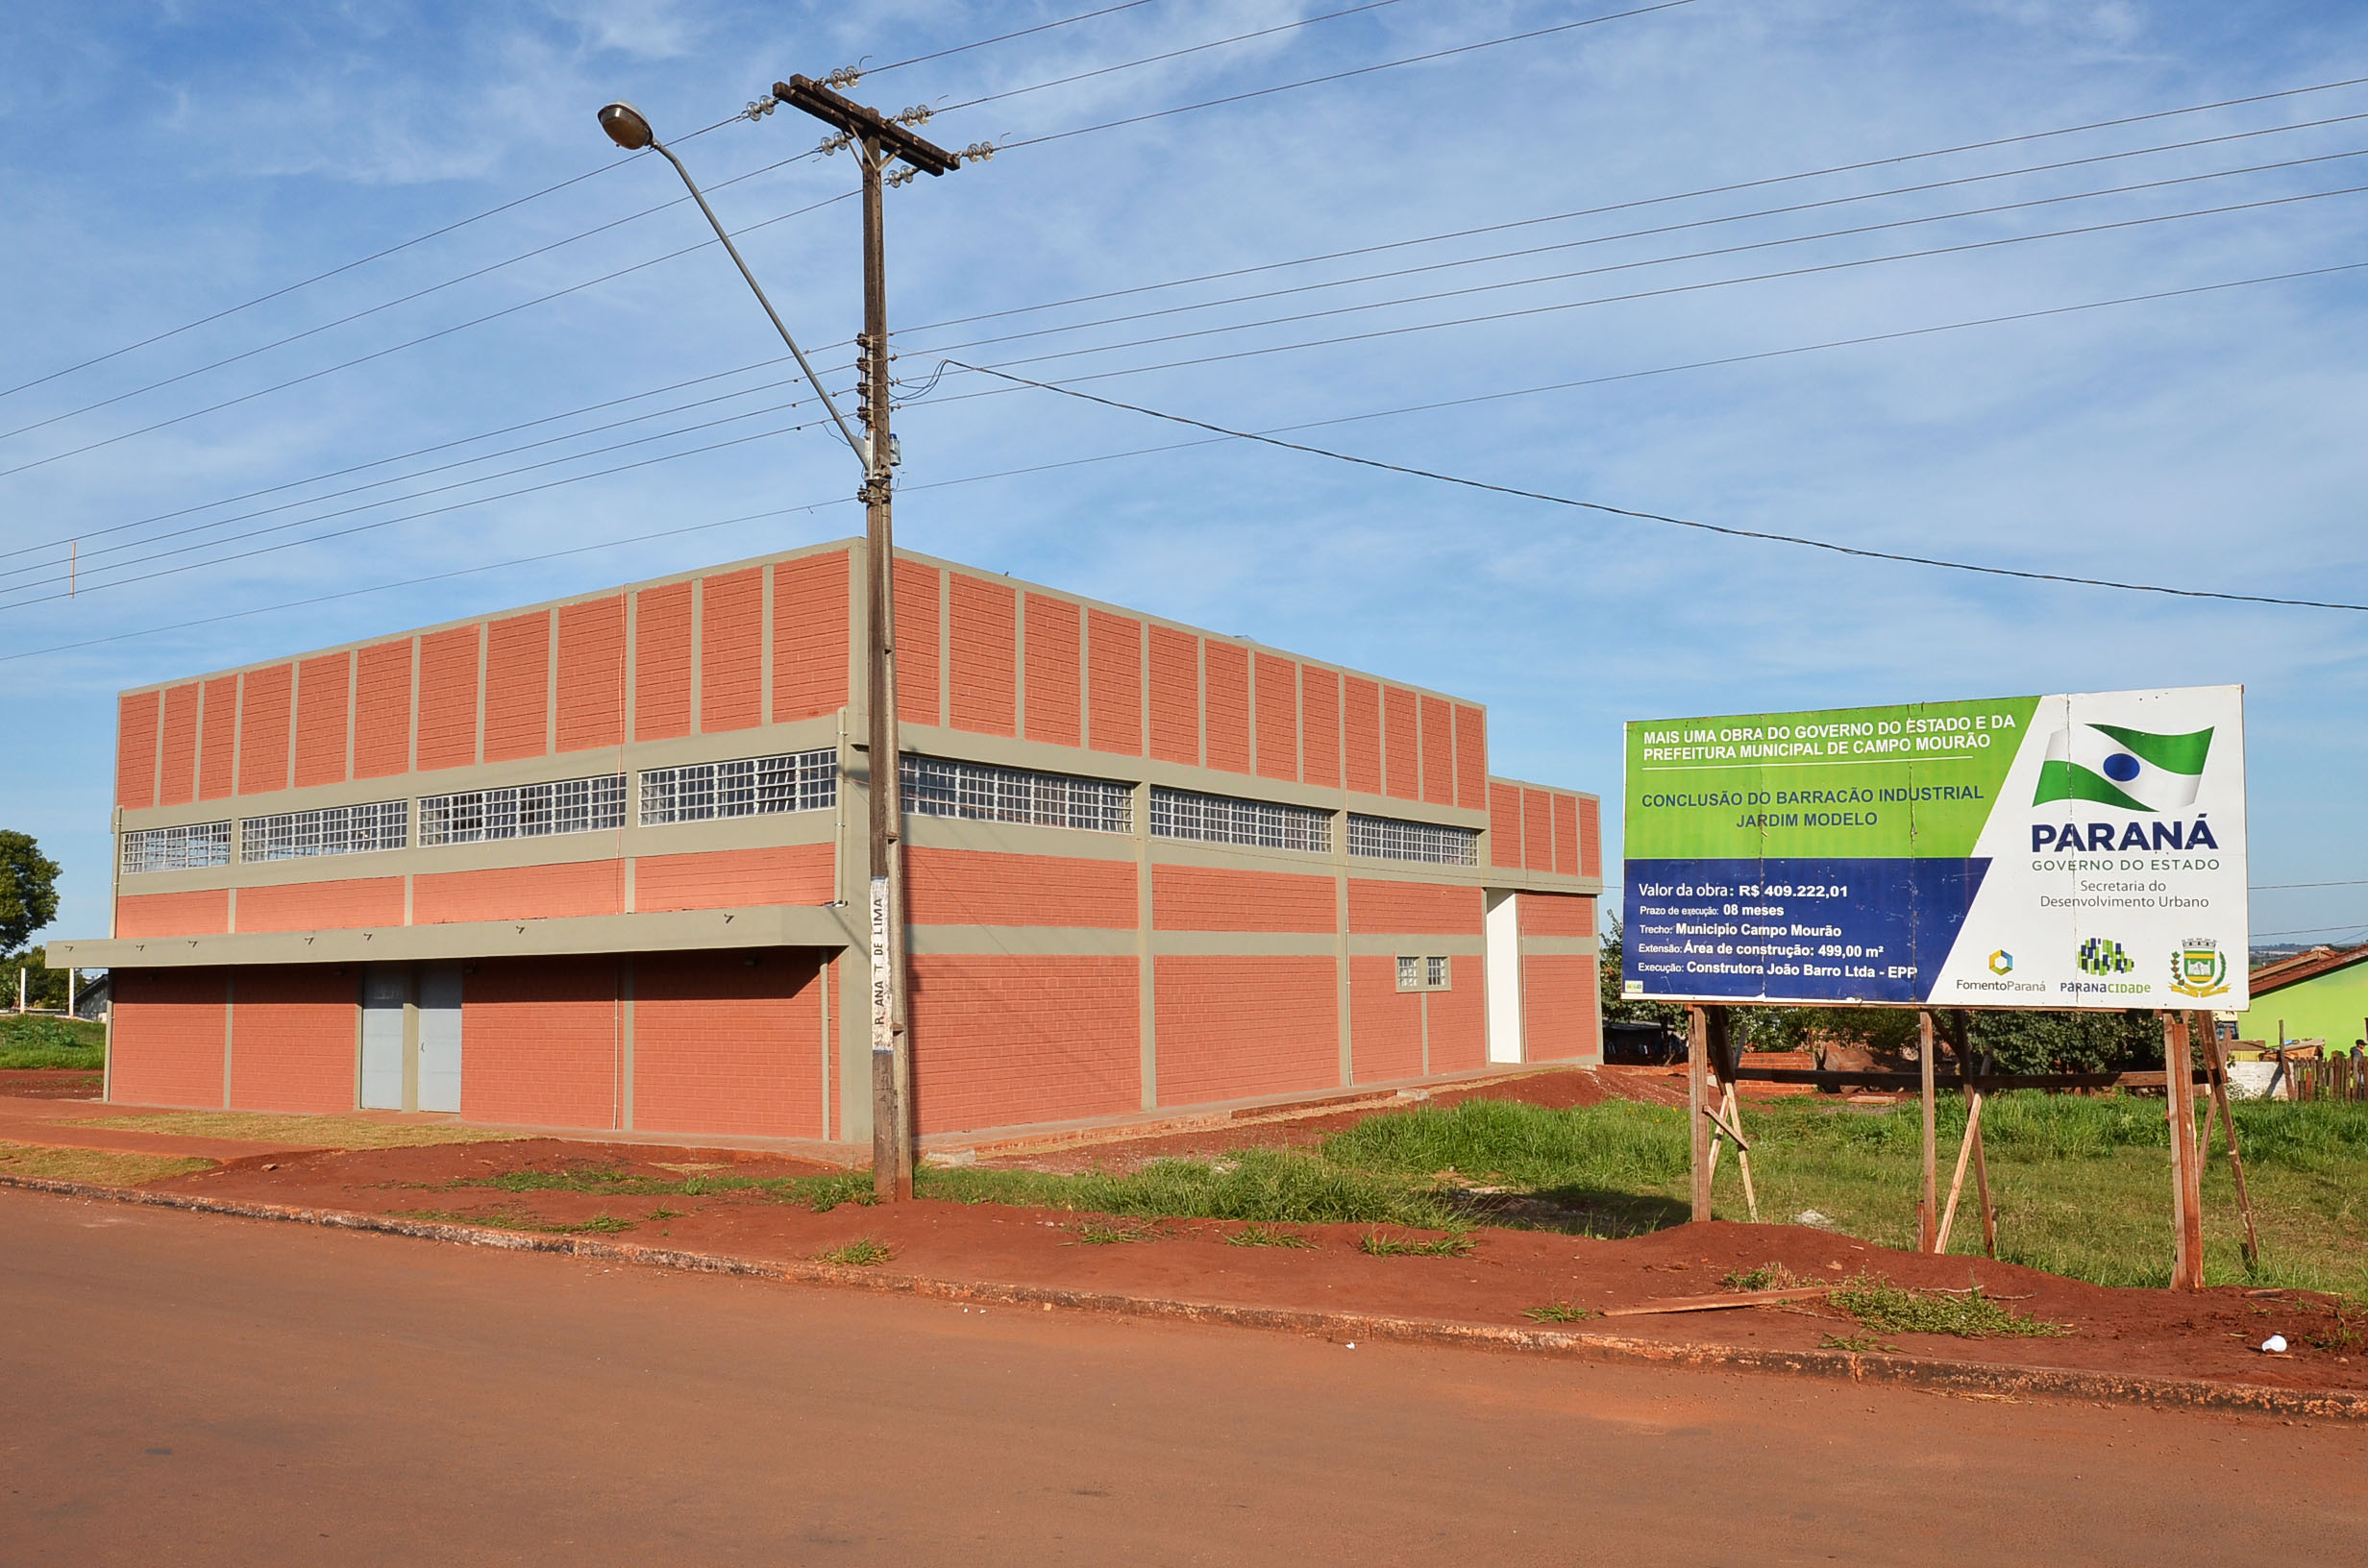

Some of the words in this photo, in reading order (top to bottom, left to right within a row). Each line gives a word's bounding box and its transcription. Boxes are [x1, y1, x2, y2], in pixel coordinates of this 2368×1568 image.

[1643, 731, 1680, 745] MAIS
[1684, 729, 1716, 743] UMA
[1720, 726, 1764, 742] OBRA
[1768, 726, 1790, 740] DO
[1794, 723, 1874, 739] GOVERNO
[1878, 721, 1902, 735] DO
[1906, 717, 1971, 733] ESTADO
[1976, 716, 1986, 729] E
[1991, 714, 2015, 729] DA
[1643, 745, 1737, 761] PREFEITURA
[1740, 742, 1824, 758] MUNICIPAL
[1827, 740, 1848, 755] DE
[1853, 738, 1912, 753] CAMPO
[1916, 733, 1990, 751] MOURÃO
[1642, 790, 1743, 808] CONCLUSÃO
[1747, 791, 1771, 806] DO
[1879, 785, 1984, 802] INDUSTRIAL
[1737, 813, 1798, 828] JARDIM
[1804, 811, 1878, 827] MODELO
[2032, 813, 2219, 853] PARANÁ
[2033, 860, 2113, 871] GOVERNO
[2120, 860, 2144, 870] DO
[2151, 859, 2220, 870] ESTADO
[1639, 884, 1673, 897] Valor
[1677, 884, 1694, 897] da
[1696, 884, 1734, 897] obra:
[1739, 884, 1760, 898] R$
[1764, 885, 1848, 899] 409.222,01
[2080, 880, 2145, 892] Secretaria
[2149, 880, 2166, 892] do
[2040, 895, 2156, 908] Desenvolvimento
[2158, 896, 2208, 908] Urbano
[874, 898, 883, 935] LIMA
[1640, 906, 1665, 916] Prazo
[1668, 906, 1679, 915] de
[1681, 906, 1719, 917] execução:
[1723, 904, 1739, 916] 08
[1742, 906, 1784, 916] meses
[1640, 925, 1673, 934] Trecho:
[1740, 924, 1788, 940] Campo
[1790, 925, 1841, 937] Mourão
[875, 943, 883, 956] DE
[1639, 943, 1682, 953] Extensão:
[1684, 940, 1714, 954] Área
[1717, 943, 1733, 954] de
[1737, 944, 1814, 958] construção:
[1818, 944, 1862, 958] 499,00
[1639, 963, 1684, 973] Execução:
[1687, 961, 1764, 974] Construtora
[1767, 963, 1799, 975] João
[1804, 965, 1840, 976] Barro
[1845, 966, 1875, 977] Ltda
[1888, 967, 1917, 979] EPP
[875, 981, 884, 1006] ANA
